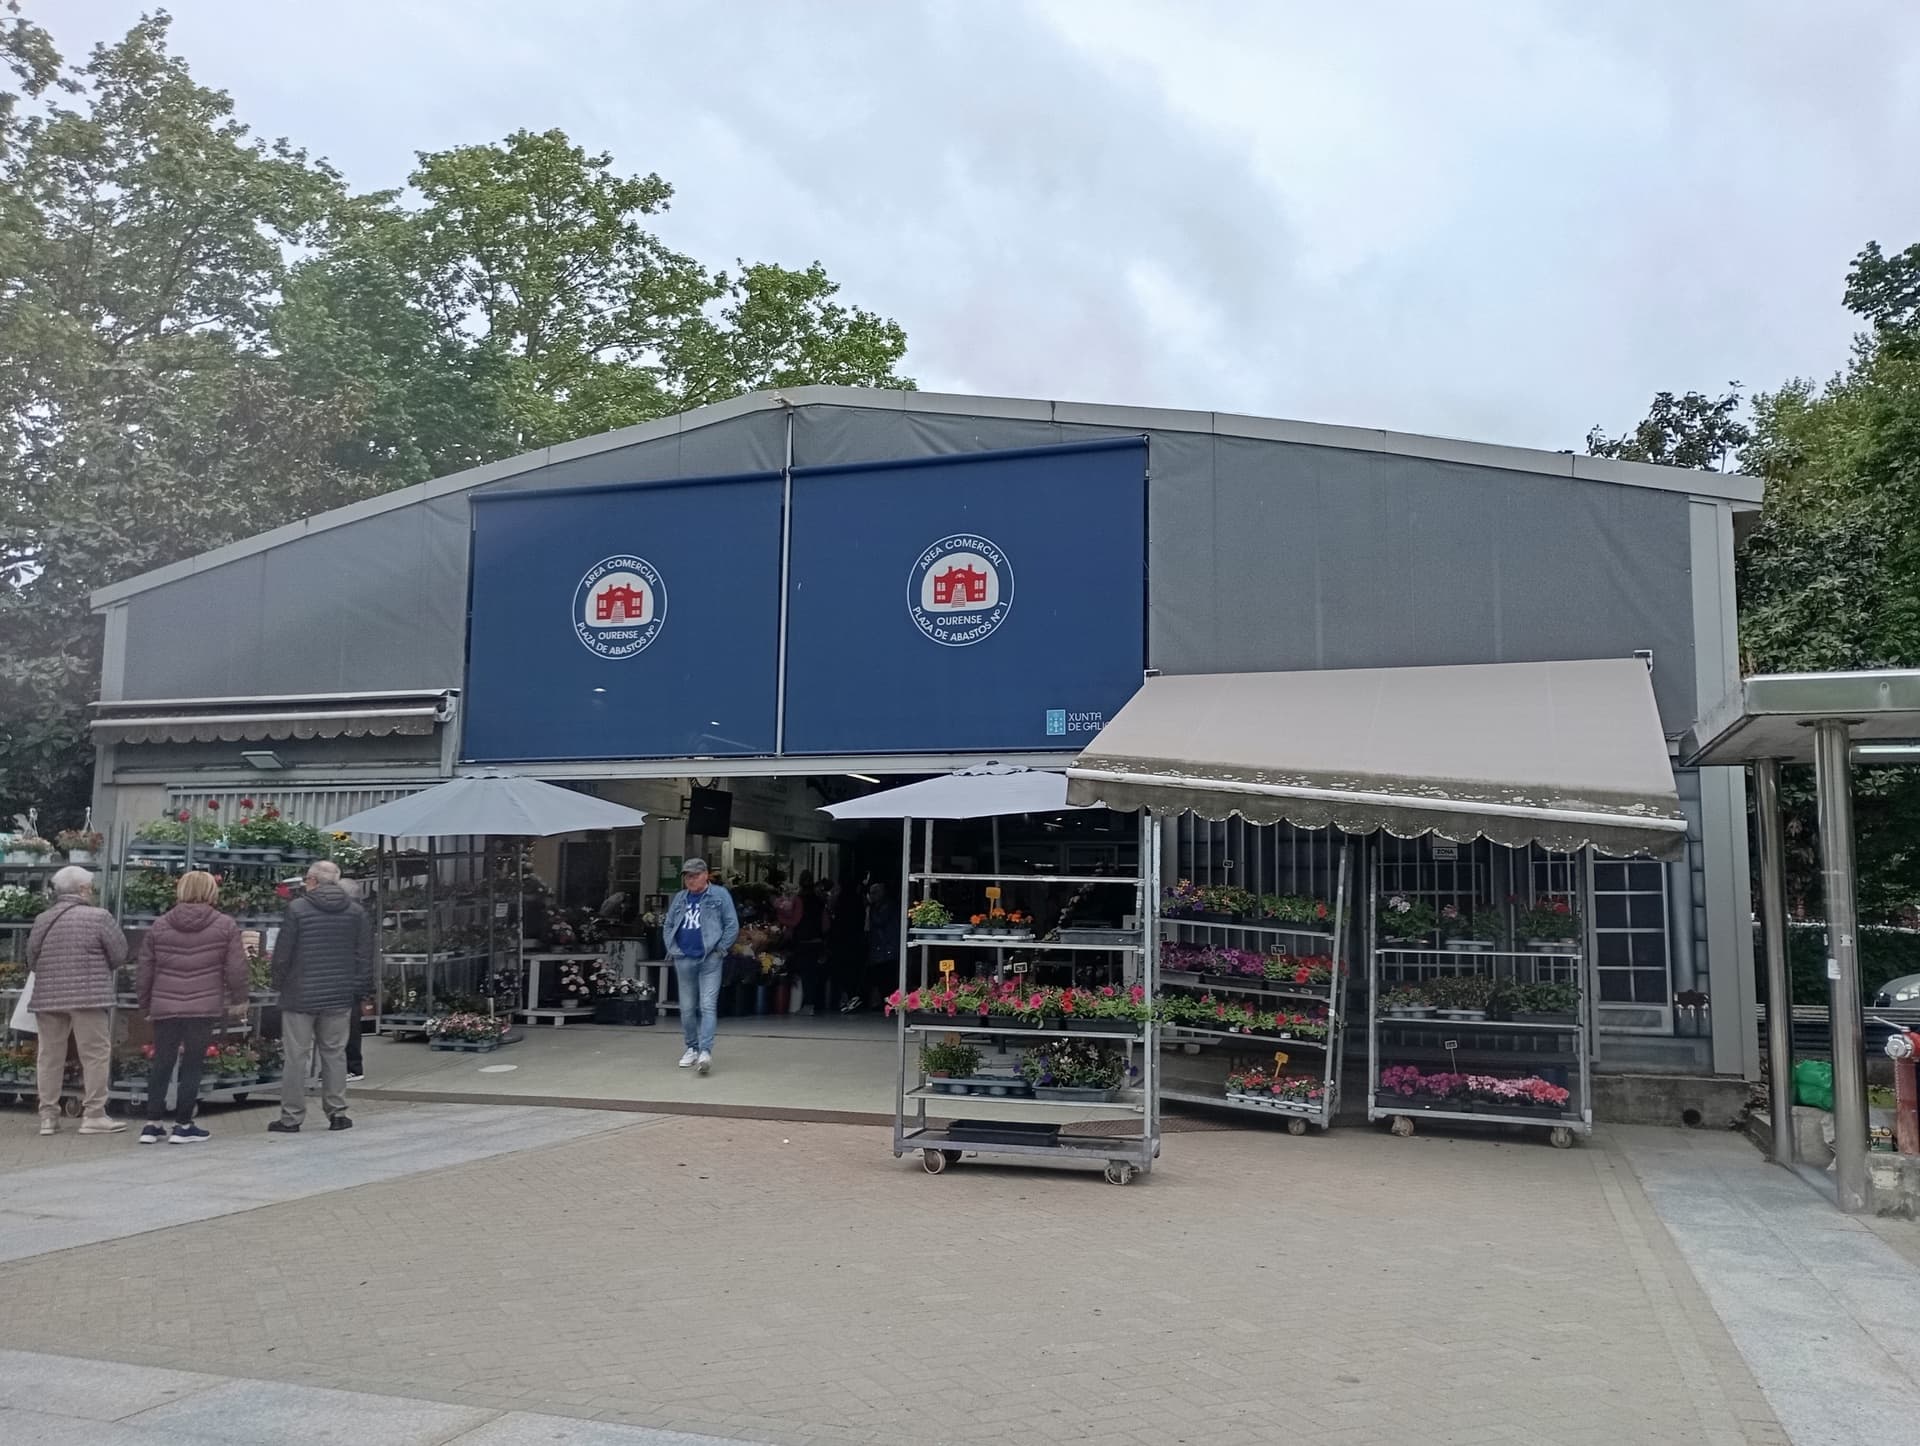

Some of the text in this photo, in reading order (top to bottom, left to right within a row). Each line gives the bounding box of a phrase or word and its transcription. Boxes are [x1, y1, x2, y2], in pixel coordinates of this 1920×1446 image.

[920, 538, 1002, 570] AREA COMERCIAL
[584, 559, 657, 588] AREA COMERCIAL
[913, 606, 933, 633] PLAZA
[935, 628, 948, 640] DE
[950, 621, 992, 641] ABASTOS
[937, 615, 982, 626] OURENSE
[577, 621, 596, 646] PLAZA
[596, 642, 608, 653] DE
[609, 636, 647, 655] ABASTOS
[598, 630, 638, 640] OURENSE
[1068, 712, 1102, 721] XUNTA
[1068, 722, 1081, 731] DE
